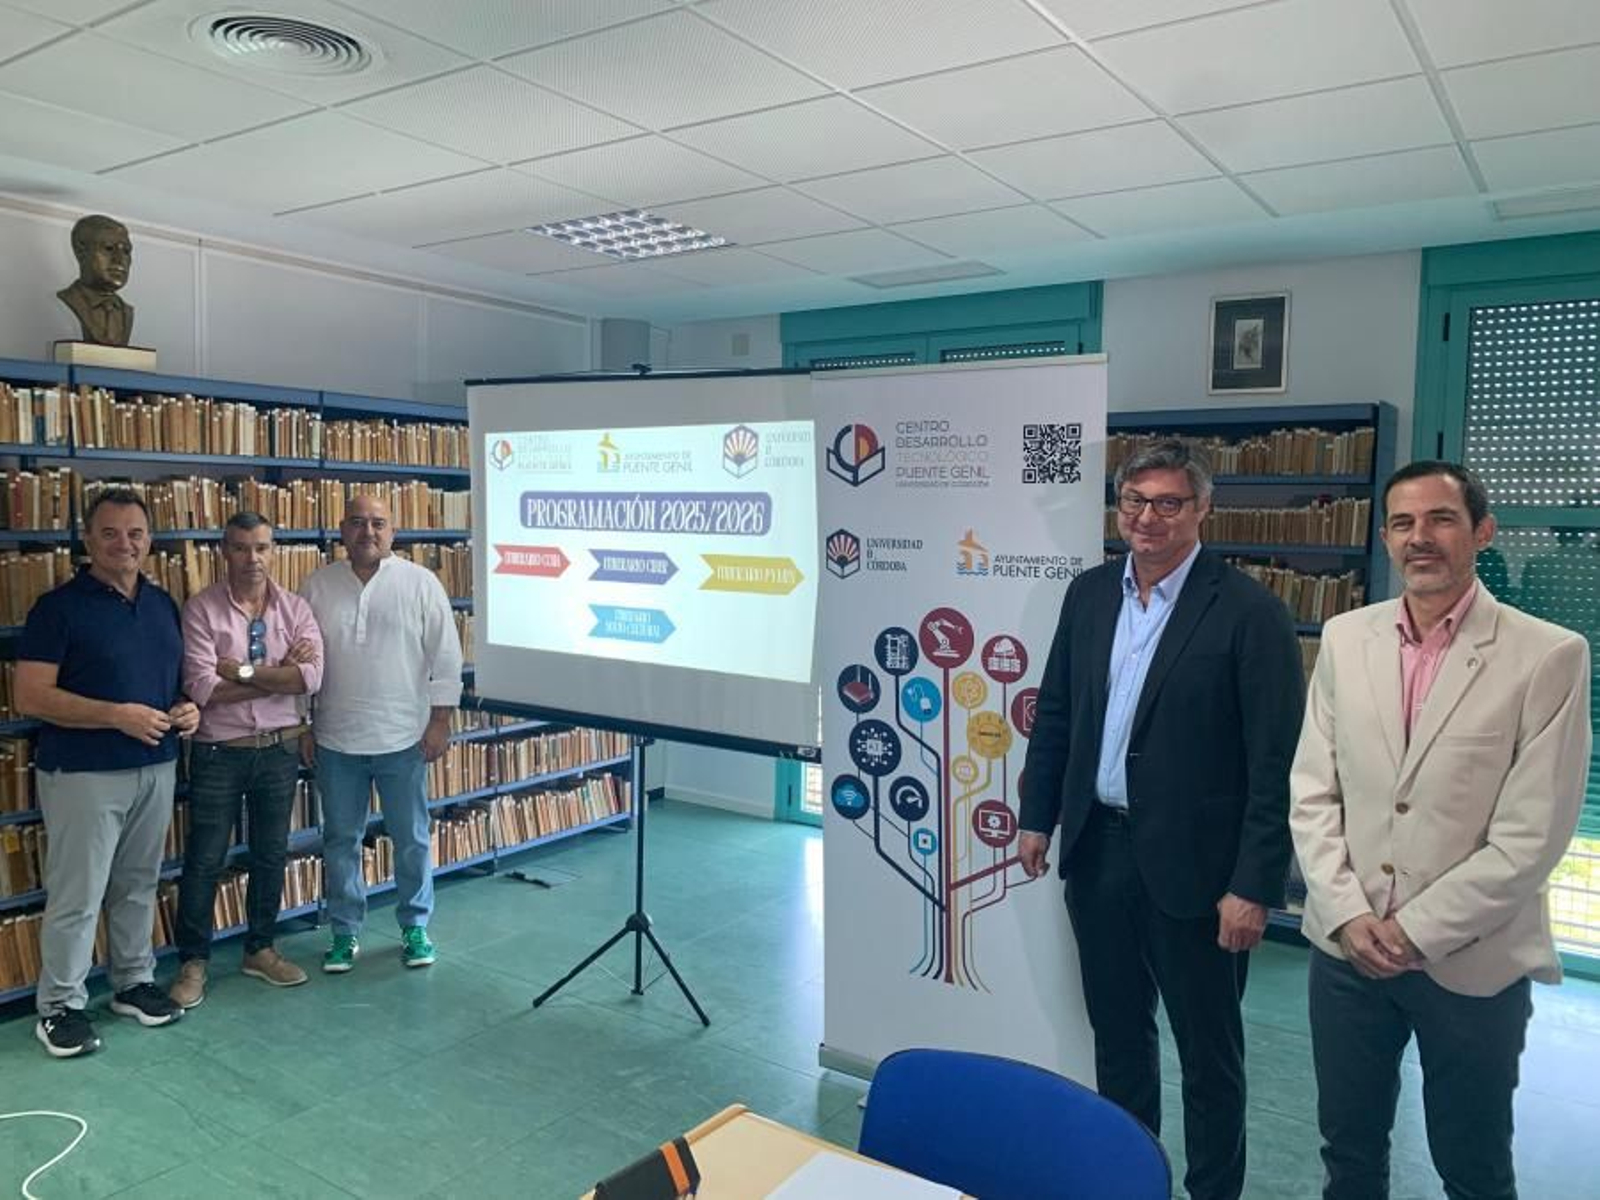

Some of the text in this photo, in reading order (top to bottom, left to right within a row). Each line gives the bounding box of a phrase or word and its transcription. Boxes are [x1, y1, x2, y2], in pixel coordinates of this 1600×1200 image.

[895, 420, 950, 434] CENTRO
[895, 434, 988, 449] DESARROLLO
[622, 461, 661, 474] PUENTE
[895, 466, 991, 479] PUENTE GENIL
[527, 494, 765, 533] PROGRAMACIÓN 2025/2026
[866, 538, 923, 550] UNIVERSIDAD
[995, 554, 1084, 566] AYUNTAMIENTO DE
[993, 564, 1041, 578] PUENTE
